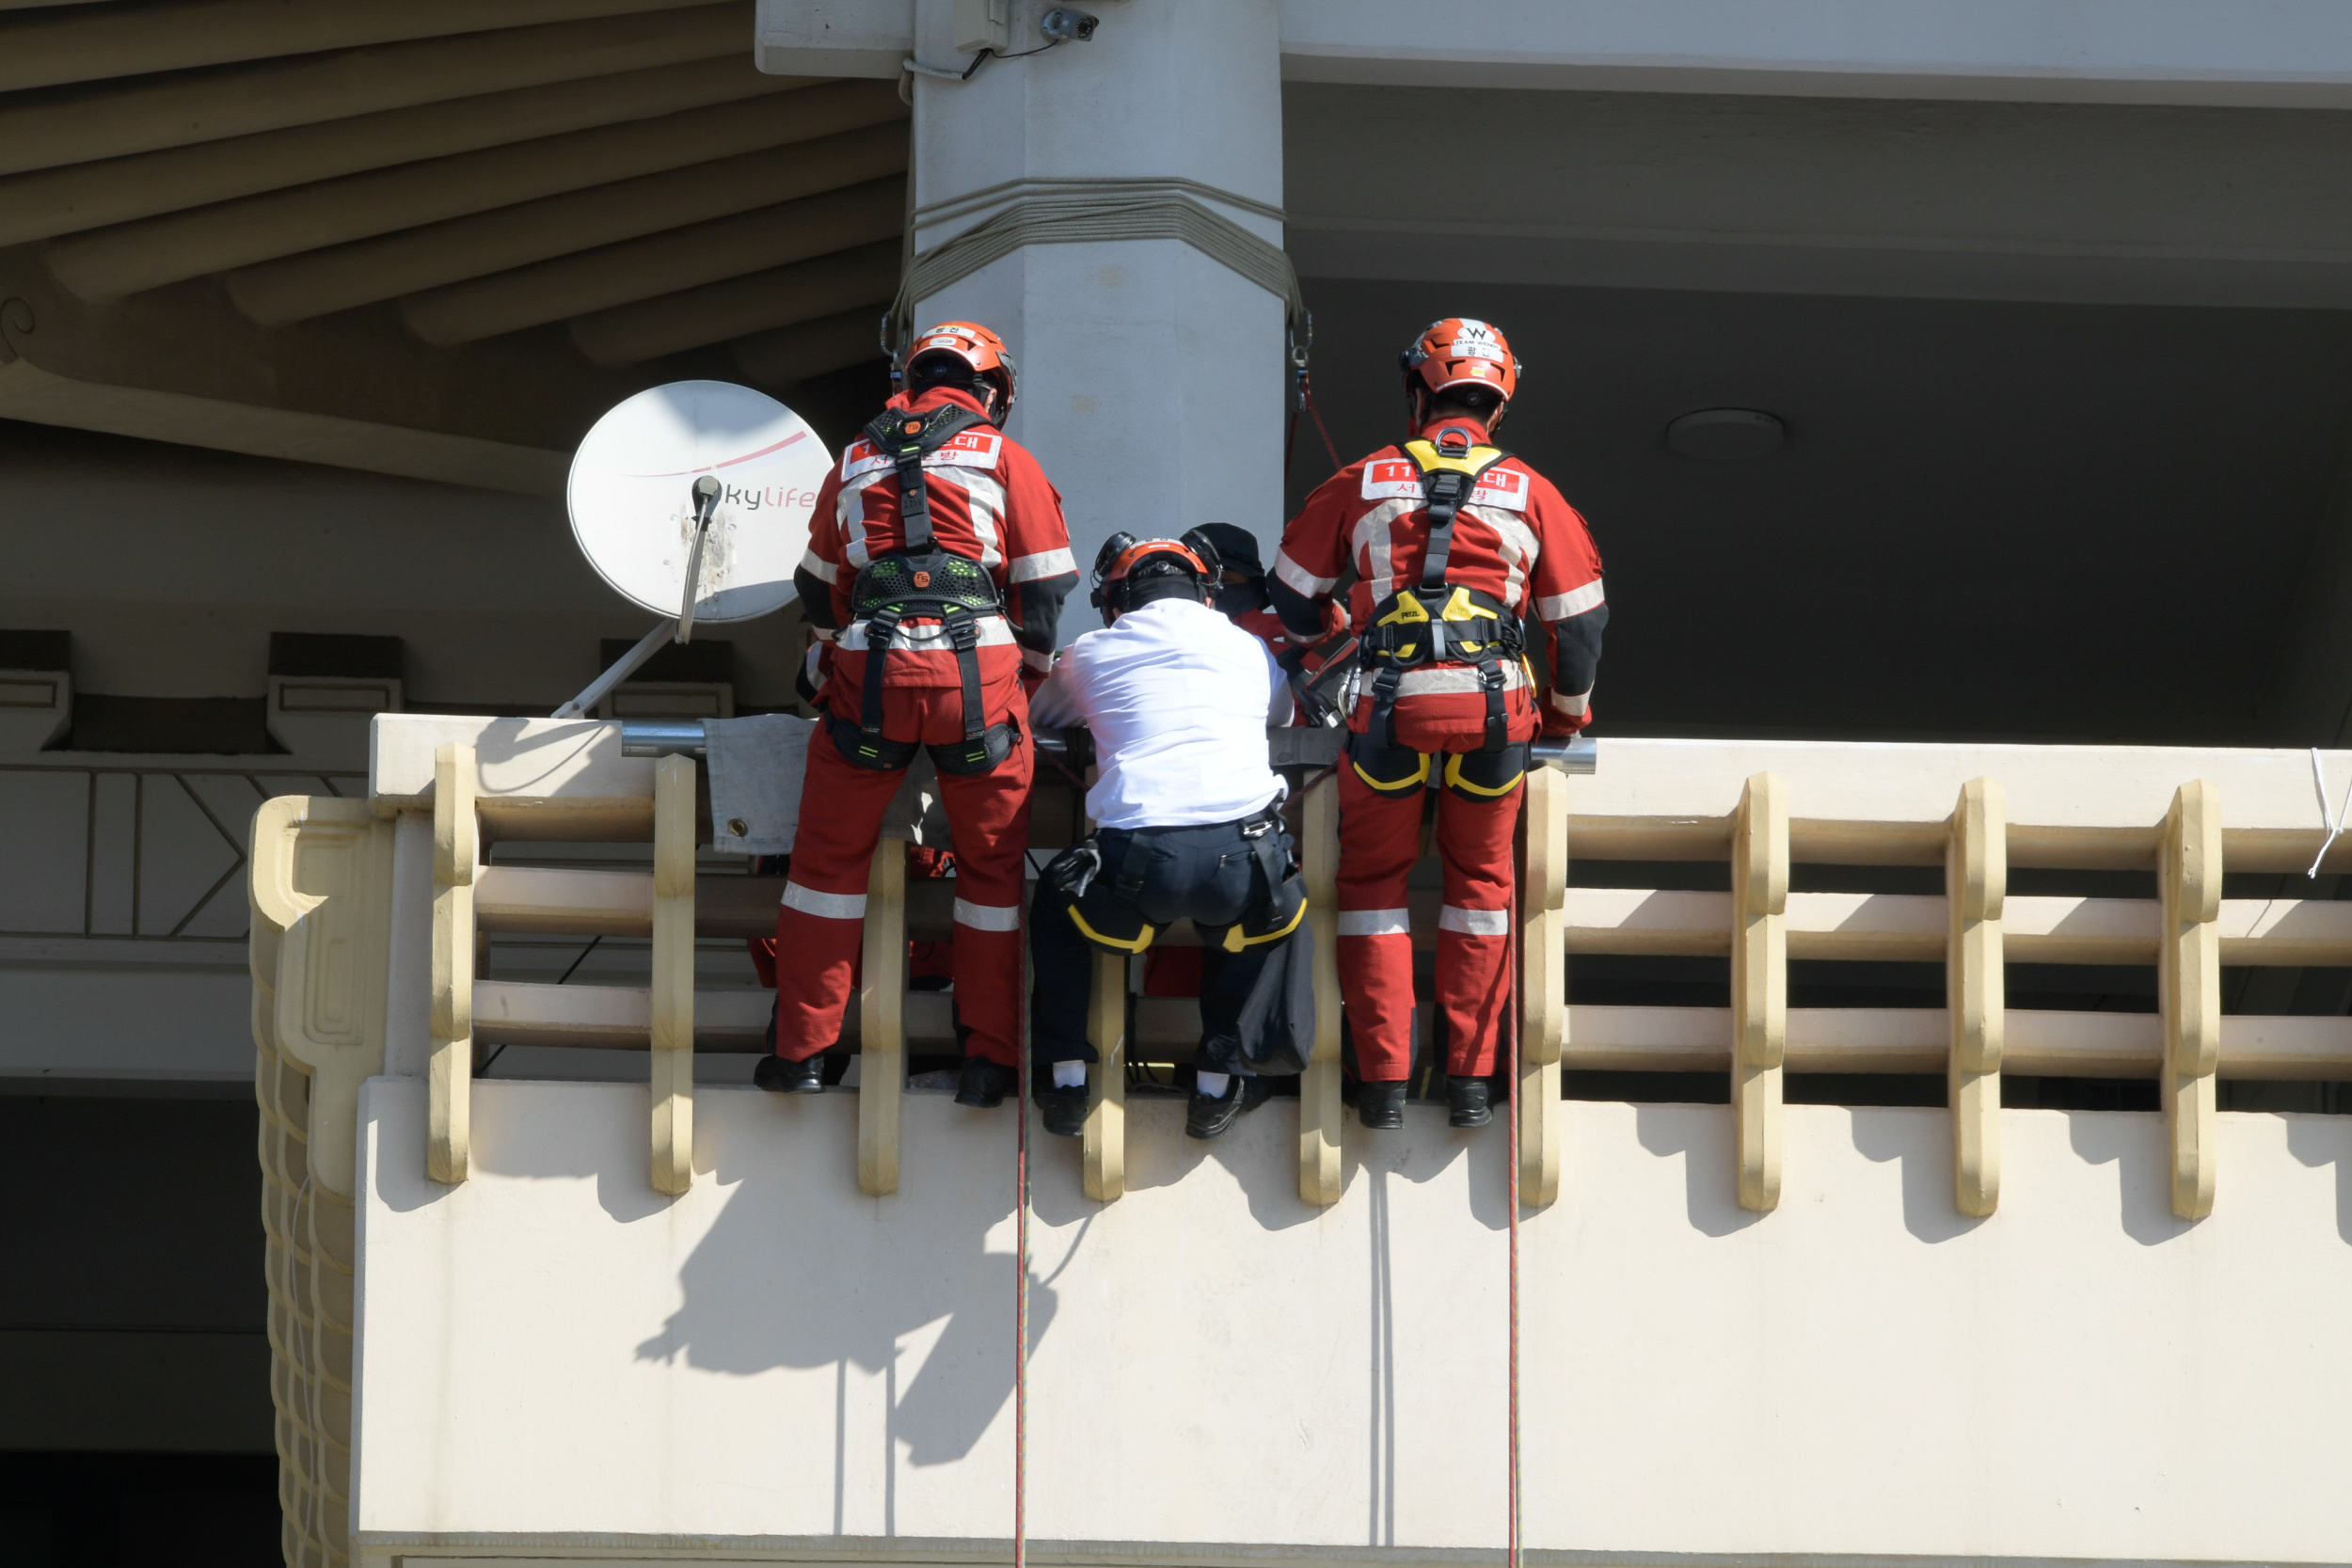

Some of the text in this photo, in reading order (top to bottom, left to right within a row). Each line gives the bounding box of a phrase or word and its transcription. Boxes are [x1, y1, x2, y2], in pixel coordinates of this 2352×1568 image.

[1467, 327, 1486, 340] W
[725, 484, 816, 510] kylife
[916, 574, 929, 582] FS
[1401, 610, 1420, 621] PETZL
